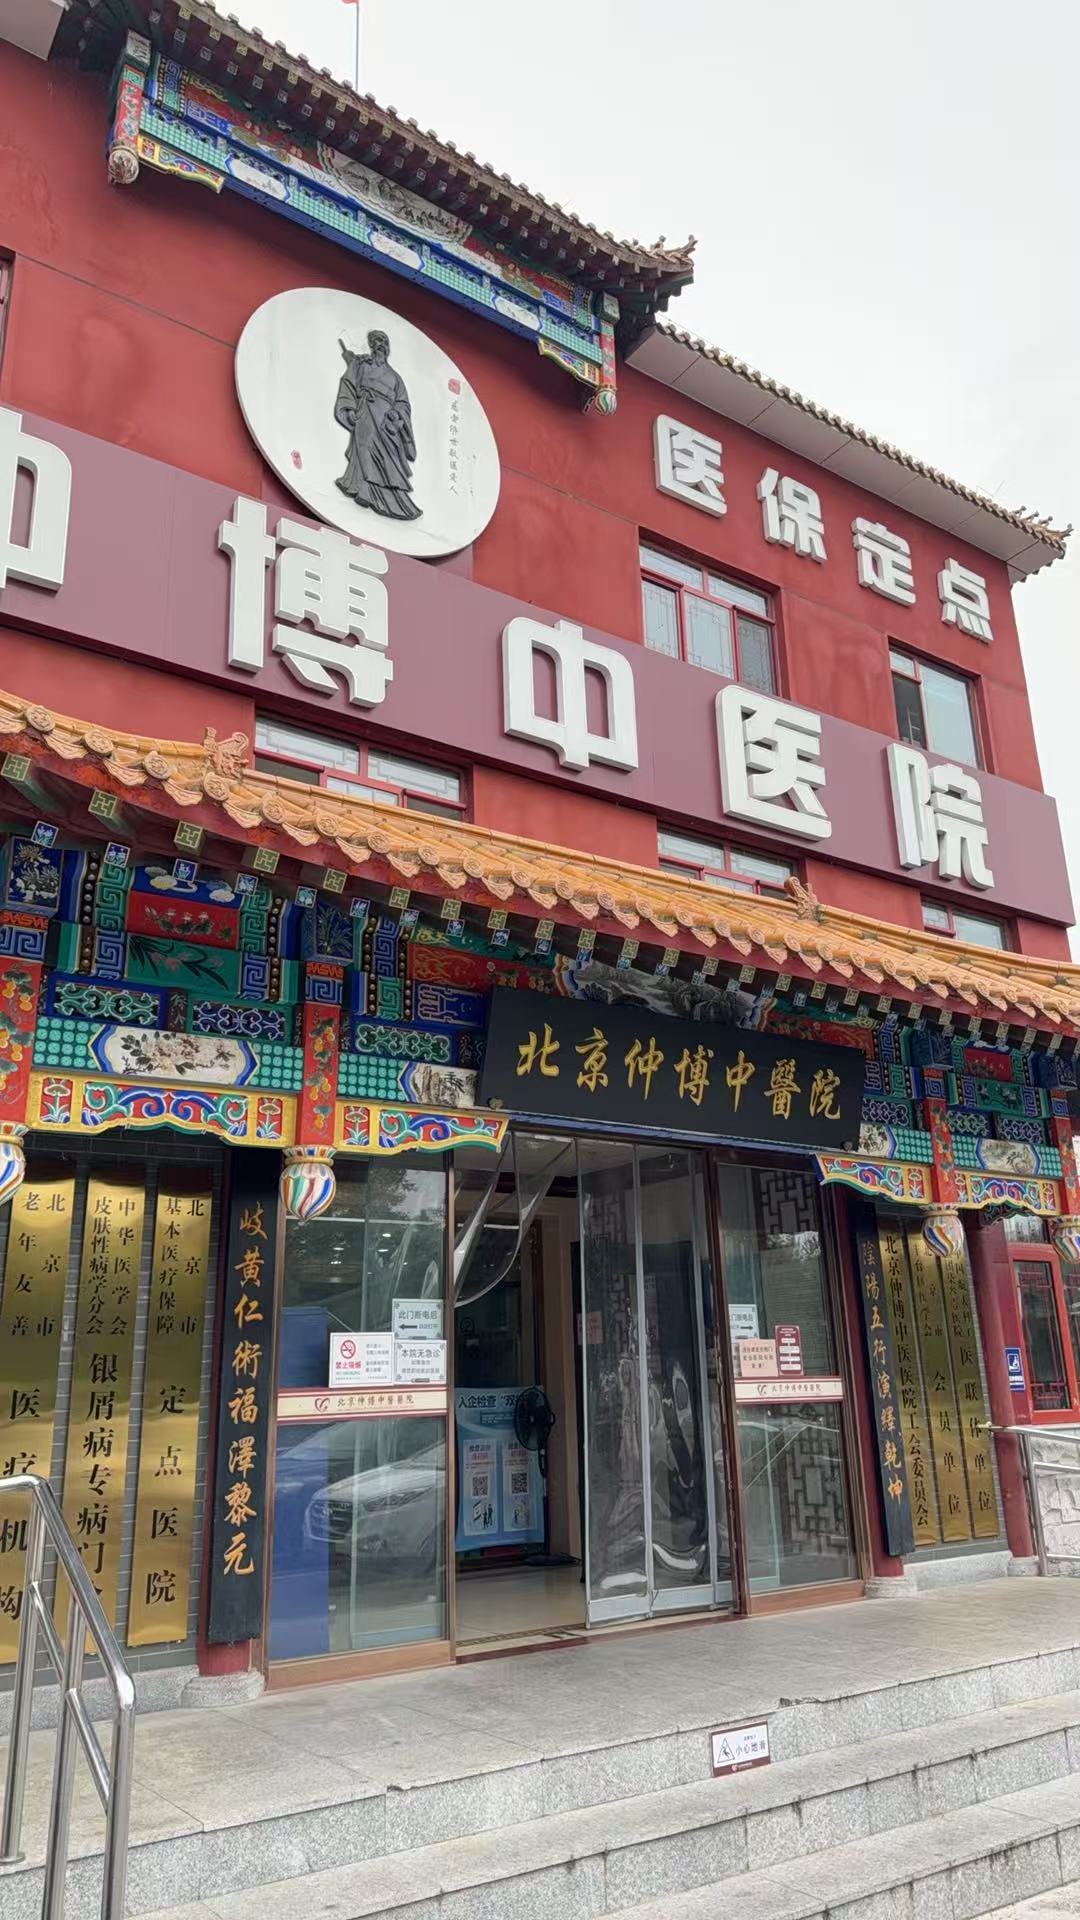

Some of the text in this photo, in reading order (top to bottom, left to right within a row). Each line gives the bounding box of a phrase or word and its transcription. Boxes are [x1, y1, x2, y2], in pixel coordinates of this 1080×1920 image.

[653, 414, 994, 643] 医保定点
[516, 1022, 842, 1121] 北京仲博中醫院
[11, 1191, 41, 1337] 老年友善
[36, 1193, 66, 1337] 北京市
[86, 1197, 112, 1336] 皮肤性病学分会
[111, 1198, 136, 1336] 中华医学会
[156, 1198, 182, 1335] 基本医疗保障
[180, 1198, 205, 1336] 北京市
[401, 1348, 441, 1359] 本院无急诊
[885, 1236, 929, 1527] 北京仲博中医医院工会委员会
[0, 1387, 41, 1621] 医疗机构
[77, 1353, 118, 1595] 银屑病专病门
[145, 1385, 187, 1605] 定点医院
[932, 1370, 962, 1516] 会员单位
